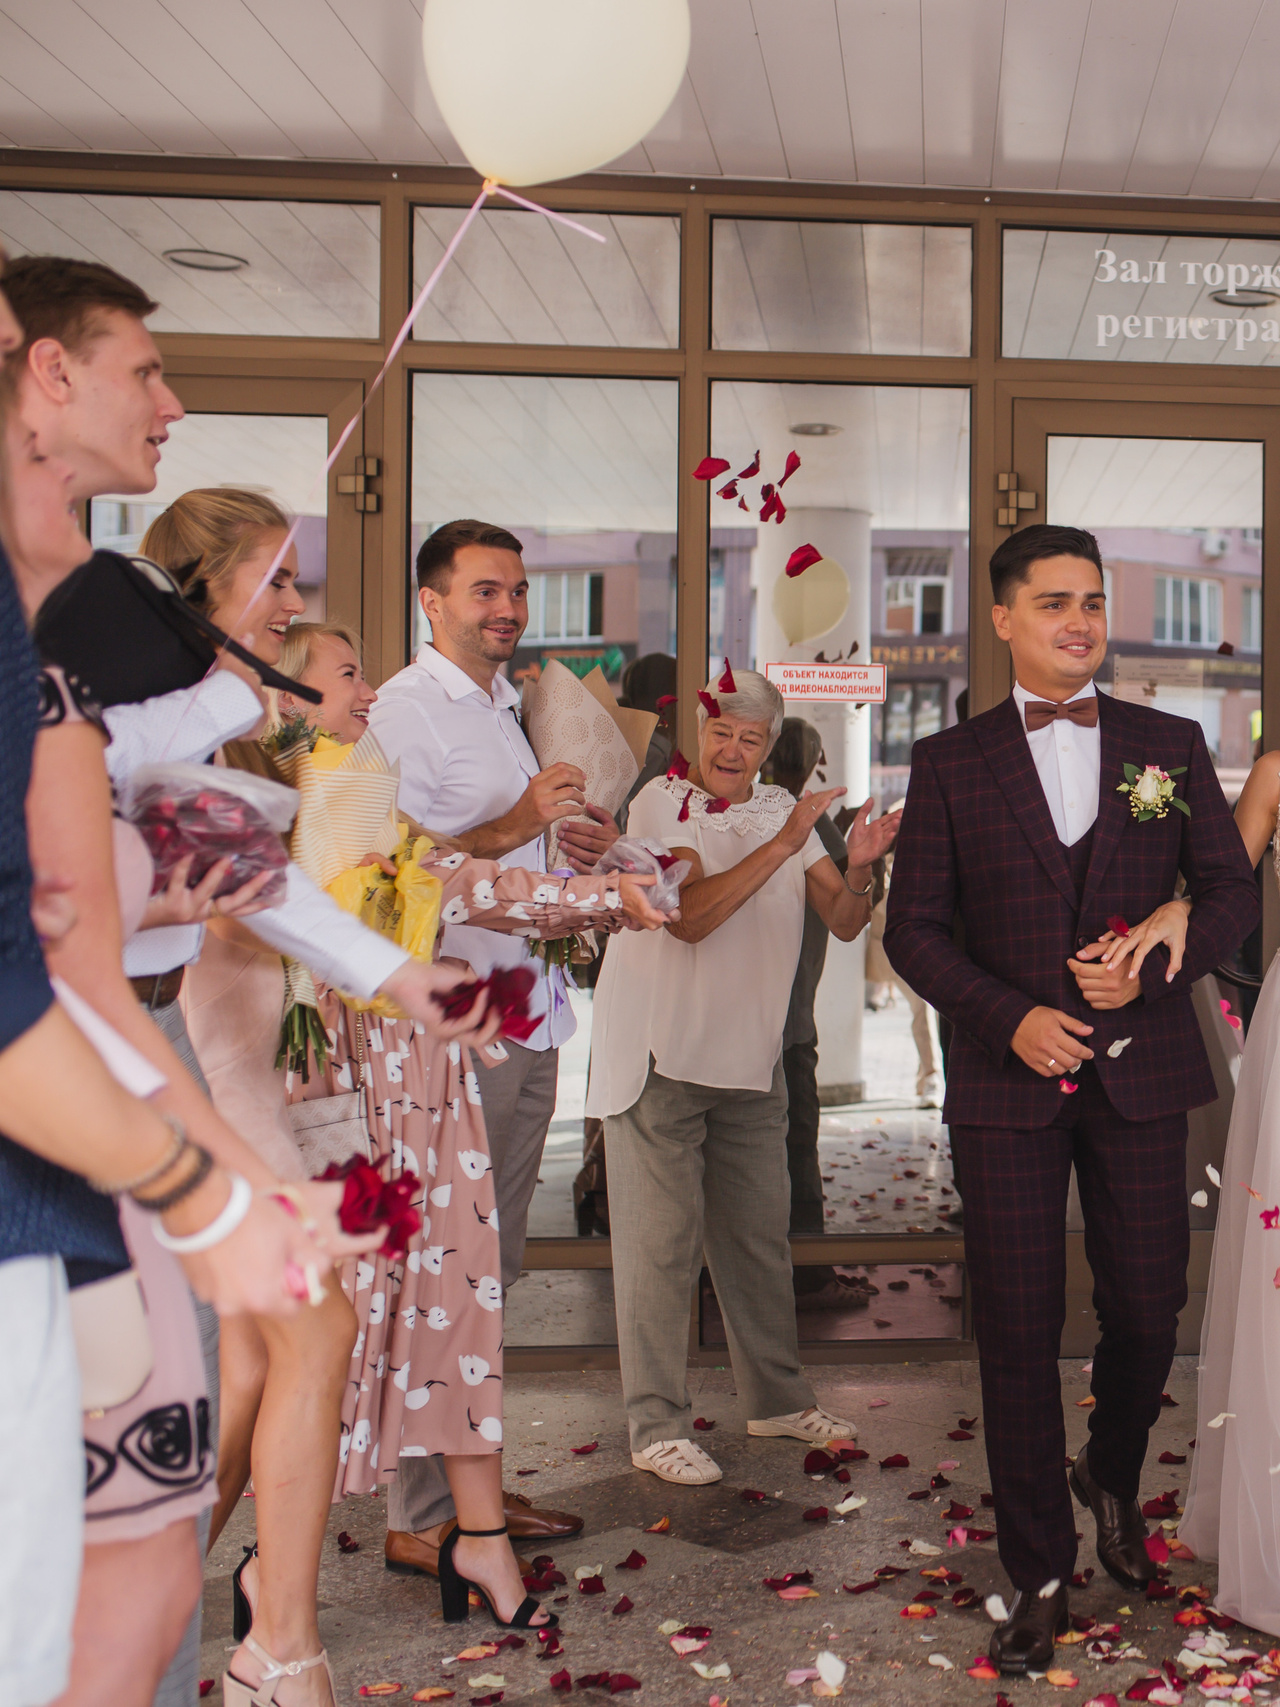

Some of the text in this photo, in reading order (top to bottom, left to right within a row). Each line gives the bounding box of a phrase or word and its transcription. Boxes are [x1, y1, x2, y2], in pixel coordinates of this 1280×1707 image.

[1094, 249, 1167, 284] Зал
[783, 669, 868, 680] ОБЪЕКТ НАХОДИТСЯ
[776, 684, 881, 694] ОД ВИДЕОНАБЛЮДЕНИЕМ
